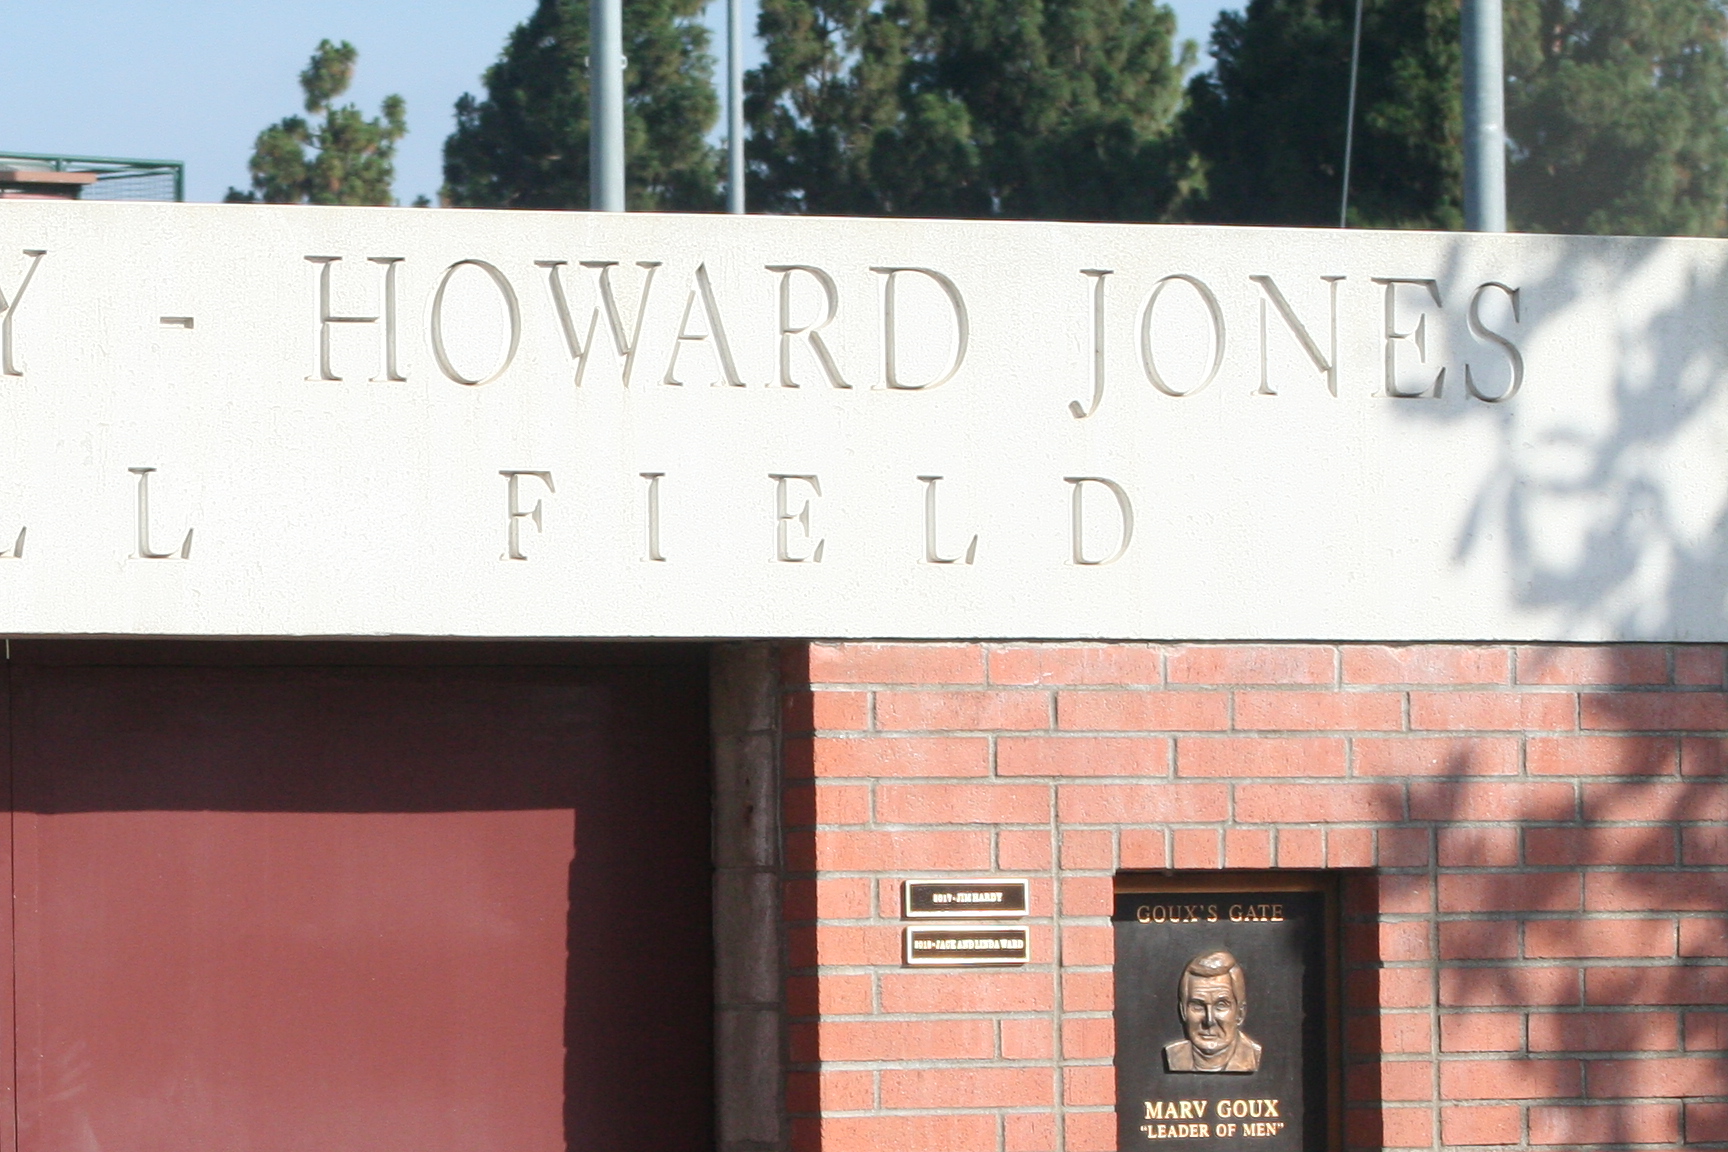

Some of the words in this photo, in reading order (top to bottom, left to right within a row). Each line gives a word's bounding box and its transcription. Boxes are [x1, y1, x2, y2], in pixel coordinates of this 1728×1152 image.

[303, 254, 970, 391] HOWARD
[1067, 267, 1525, 419] JONES
[498, 469, 1134, 566] FIELD
[1137, 905, 1218, 923] GOUX'S
[1228, 904, 1284, 922] GATE
[1145, 1101, 1207, 1119] MARV
[1217, 1100, 1278, 1118] GOUX
[1141, 1124, 1209, 1138] "LEADER
[1216, 1124, 1236, 1137] OF
[1243, 1123, 1283, 1136] MEN"
